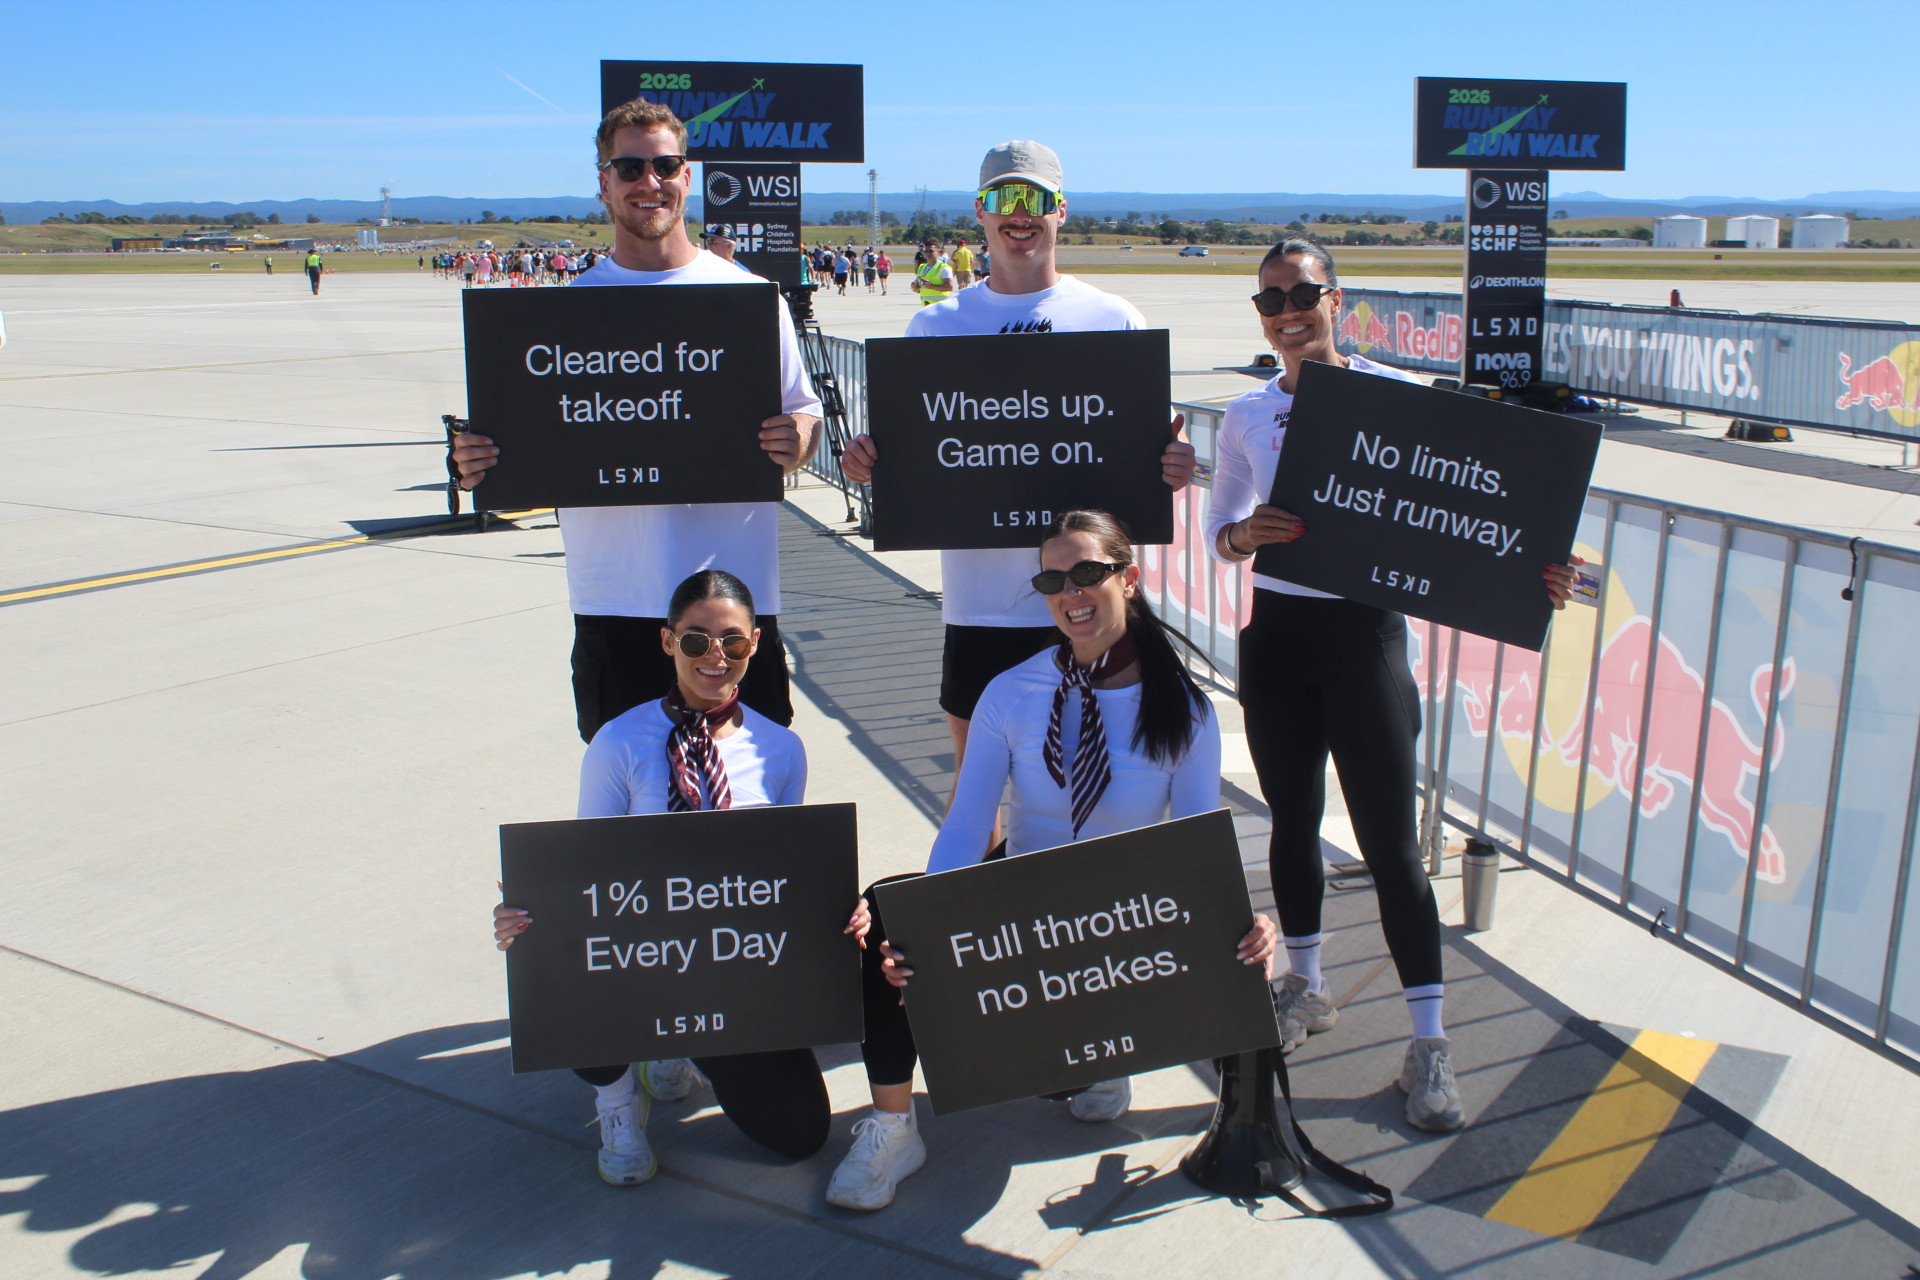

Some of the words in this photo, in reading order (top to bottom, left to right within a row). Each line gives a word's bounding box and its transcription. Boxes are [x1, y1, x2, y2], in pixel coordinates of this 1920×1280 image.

[639, 73, 692, 89] 2026
[1448, 89, 1491, 105] 2026
[1443, 105, 1558, 131] RUNWAY
[741, 122, 832, 149] WALK
[1465, 132, 1521, 157] RUN
[1528, 134, 1601, 158] WALK
[747, 175, 798, 197] WSI
[1505, 182, 1547, 201] WSI
[766, 223, 788, 231] Sydney
[1471, 237, 1518, 251] SCHF
[1485, 277, 1544, 287] DECATHLON
[1473, 317, 1537, 336] LSKD
[525, 342, 663, 376] Cleared
[674, 341, 724, 372] for
[1476, 352, 1532, 371] nova
[1581, 325, 1632, 382] YOU
[1500, 370, 1532, 389] 96.9
[558, 389, 691, 423] takeoff.
[922, 389, 1049, 422] Wheels
[1061, 394, 1114, 425] up.
[937, 437, 1040, 468] Game
[1051, 441, 1103, 465] on.
[1352, 431, 1400, 470] No
[1410, 444, 1508, 497] limits.
[599, 467, 660, 484] LSKD
[993, 510, 1052, 527] LSKD
[1313, 474, 1386, 517] Just
[1393, 499, 1523, 557] runway.
[1371, 566, 1431, 597] LSKD
[582, 880, 649, 917] 1%
[666, 875, 788, 912] Better
[950, 923, 1023, 968] Full
[1033, 893, 1191, 949] throttle,
[586, 936, 697, 974] Every
[711, 927, 788, 966] Day
[977, 984, 1028, 1015] no
[1038, 950, 1189, 1002] brakes.
[656, 1013, 724, 1036] LSKD
[1065, 1036, 1135, 1065] LSKD
